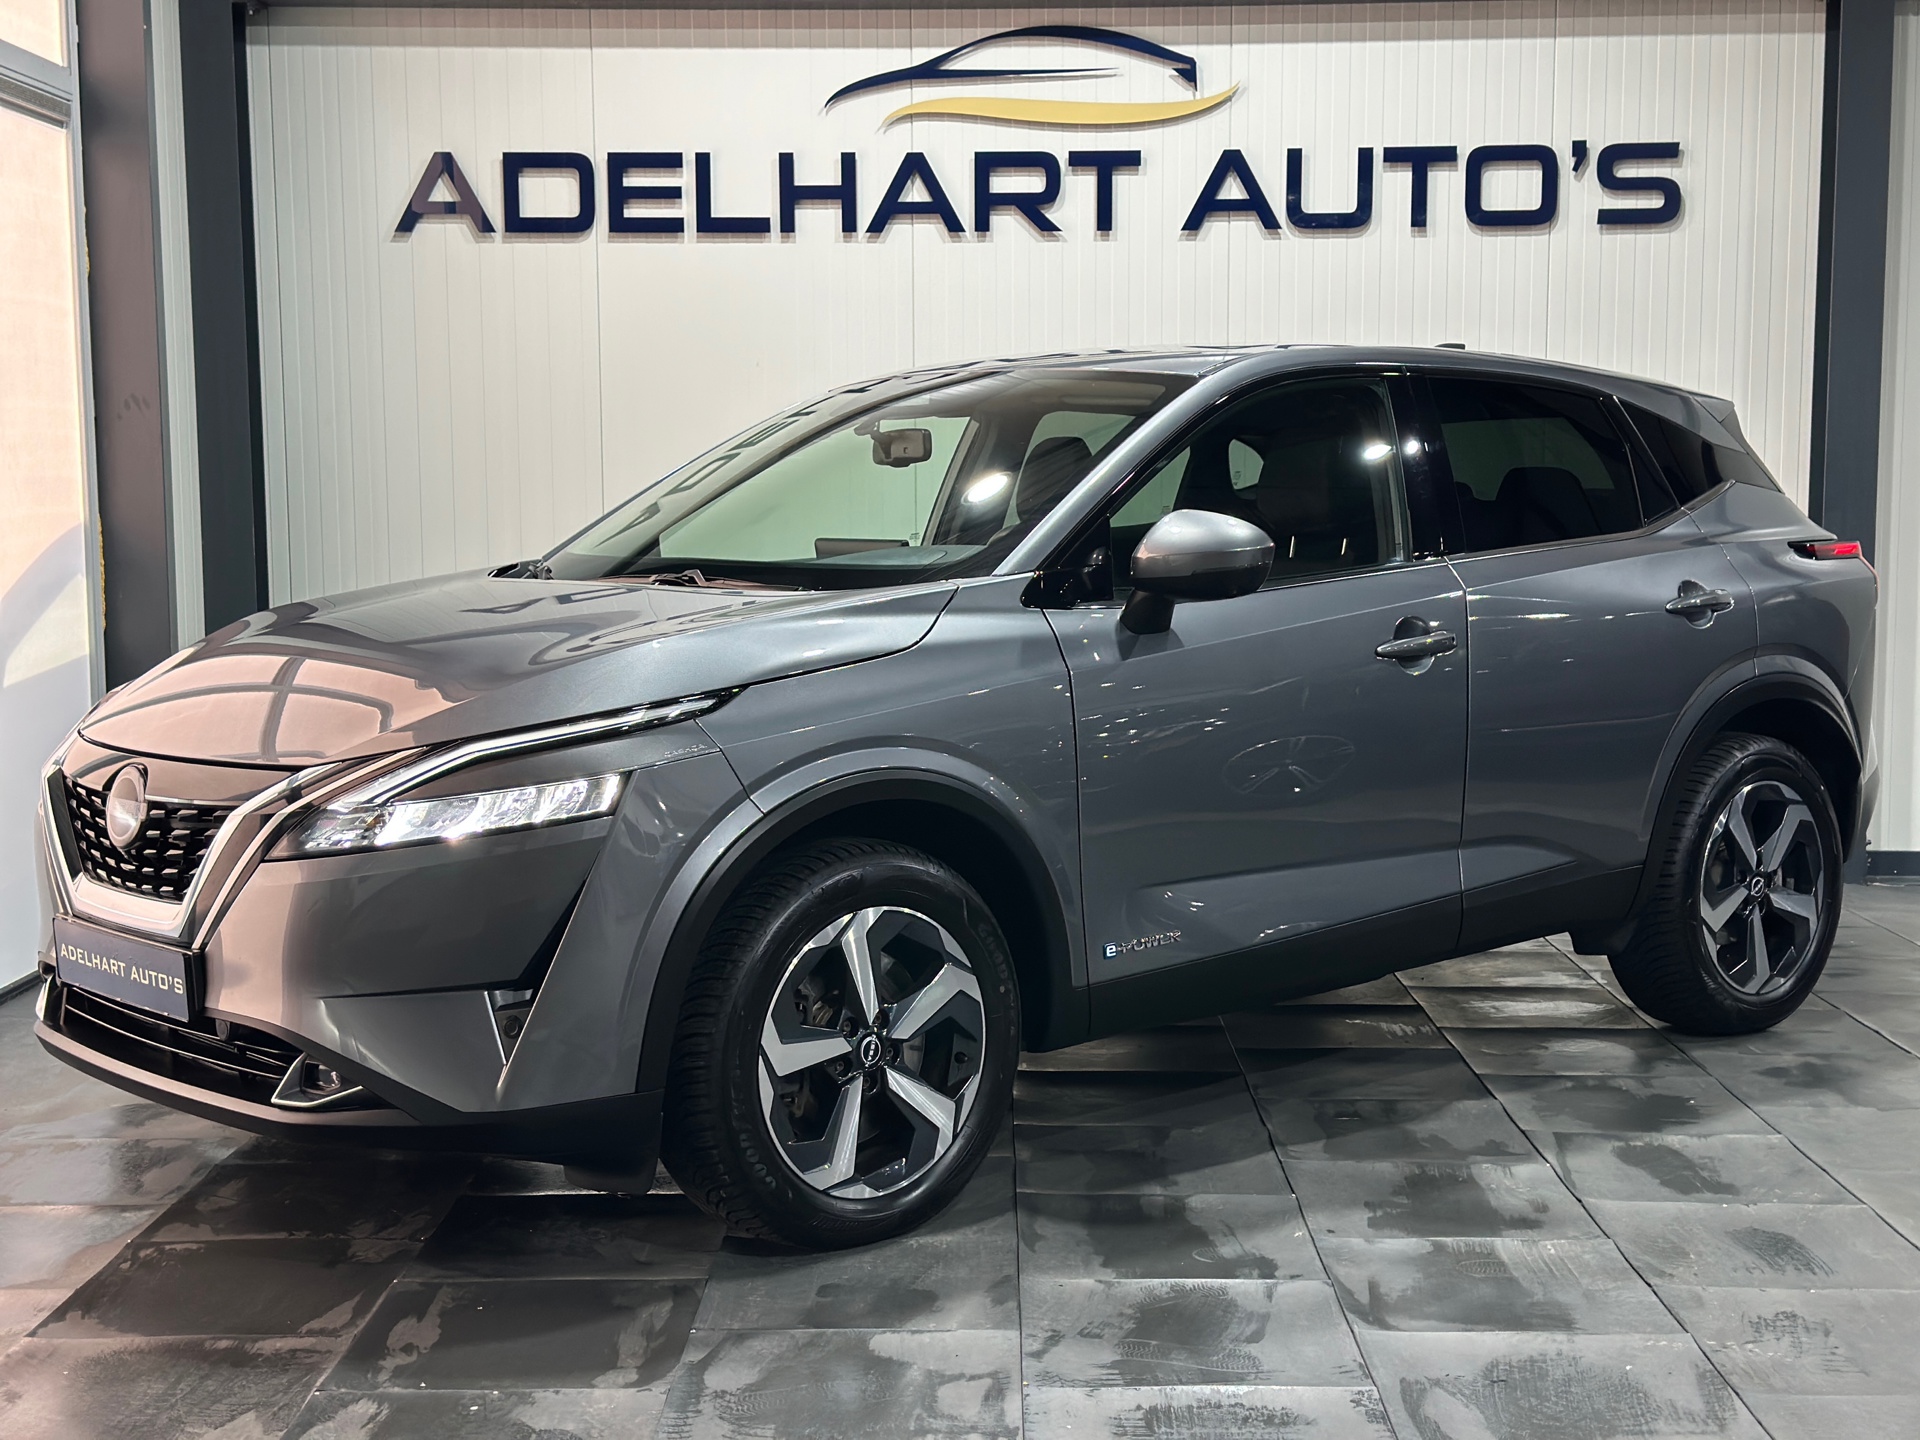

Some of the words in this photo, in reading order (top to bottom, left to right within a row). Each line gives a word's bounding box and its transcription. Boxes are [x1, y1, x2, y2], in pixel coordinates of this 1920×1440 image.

[393, 149, 1142, 234] ADELHART
[1180, 139, 1682, 231] AUTO'S
[60, 943, 126, 977] ADELHART
[130, 965, 184, 995] AUTO'S
